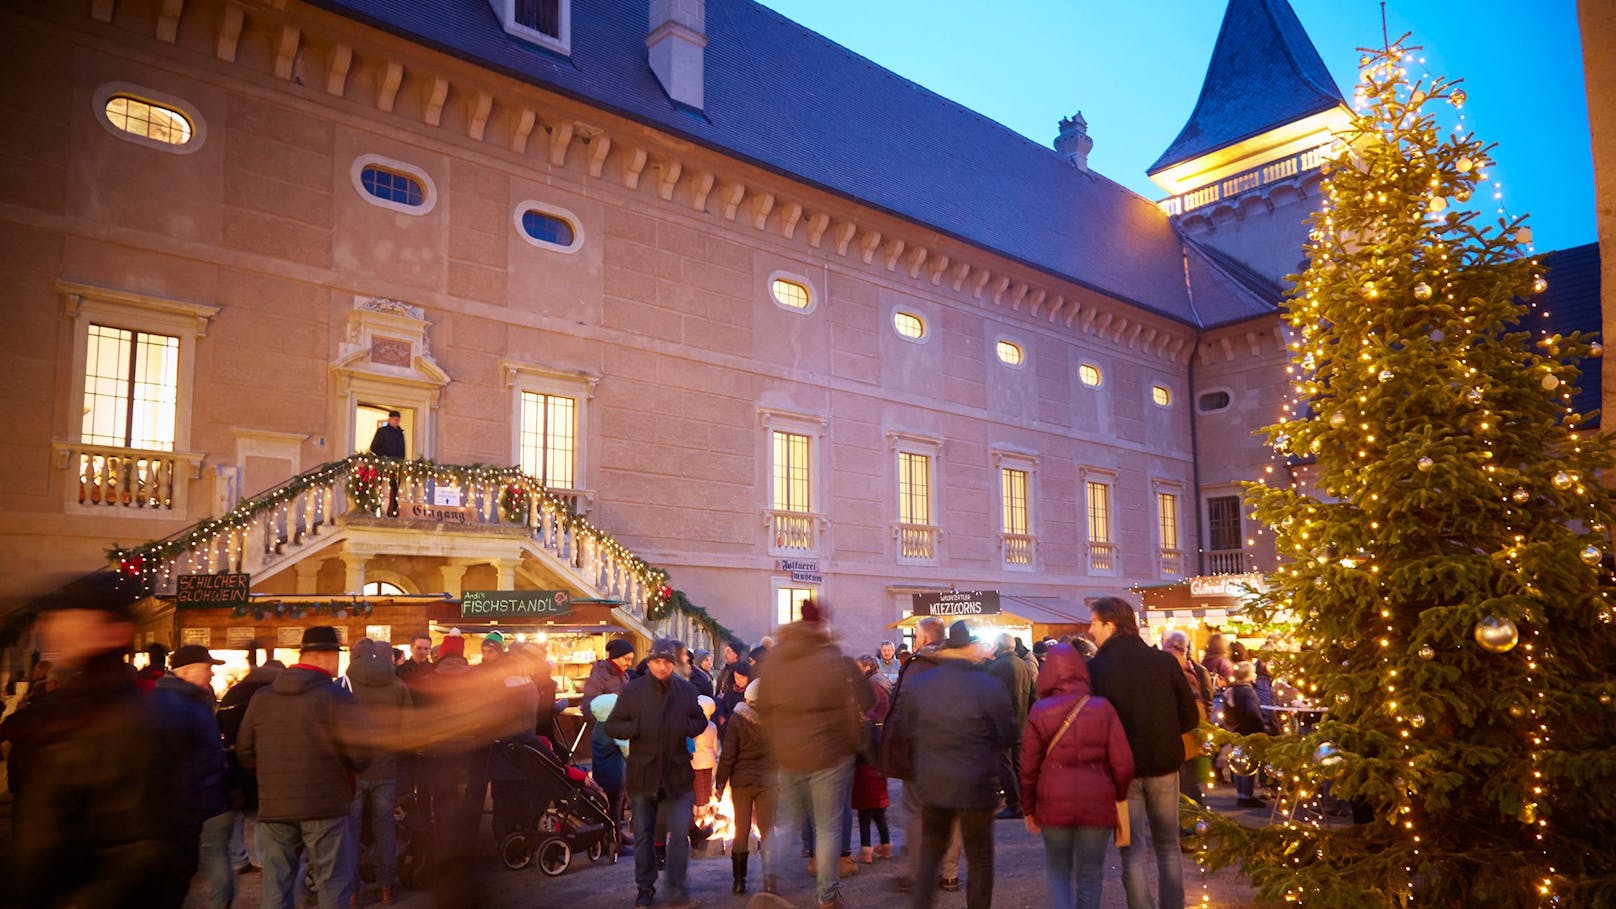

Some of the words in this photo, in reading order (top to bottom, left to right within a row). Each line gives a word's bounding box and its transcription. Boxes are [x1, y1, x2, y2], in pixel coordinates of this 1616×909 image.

[412, 504, 465, 524] Eingang
[180, 575, 247, 590] SCHILCHER
[463, 598, 557, 613] FISCHSTAND'L
[929, 601, 982, 616] MIEZICORNS
